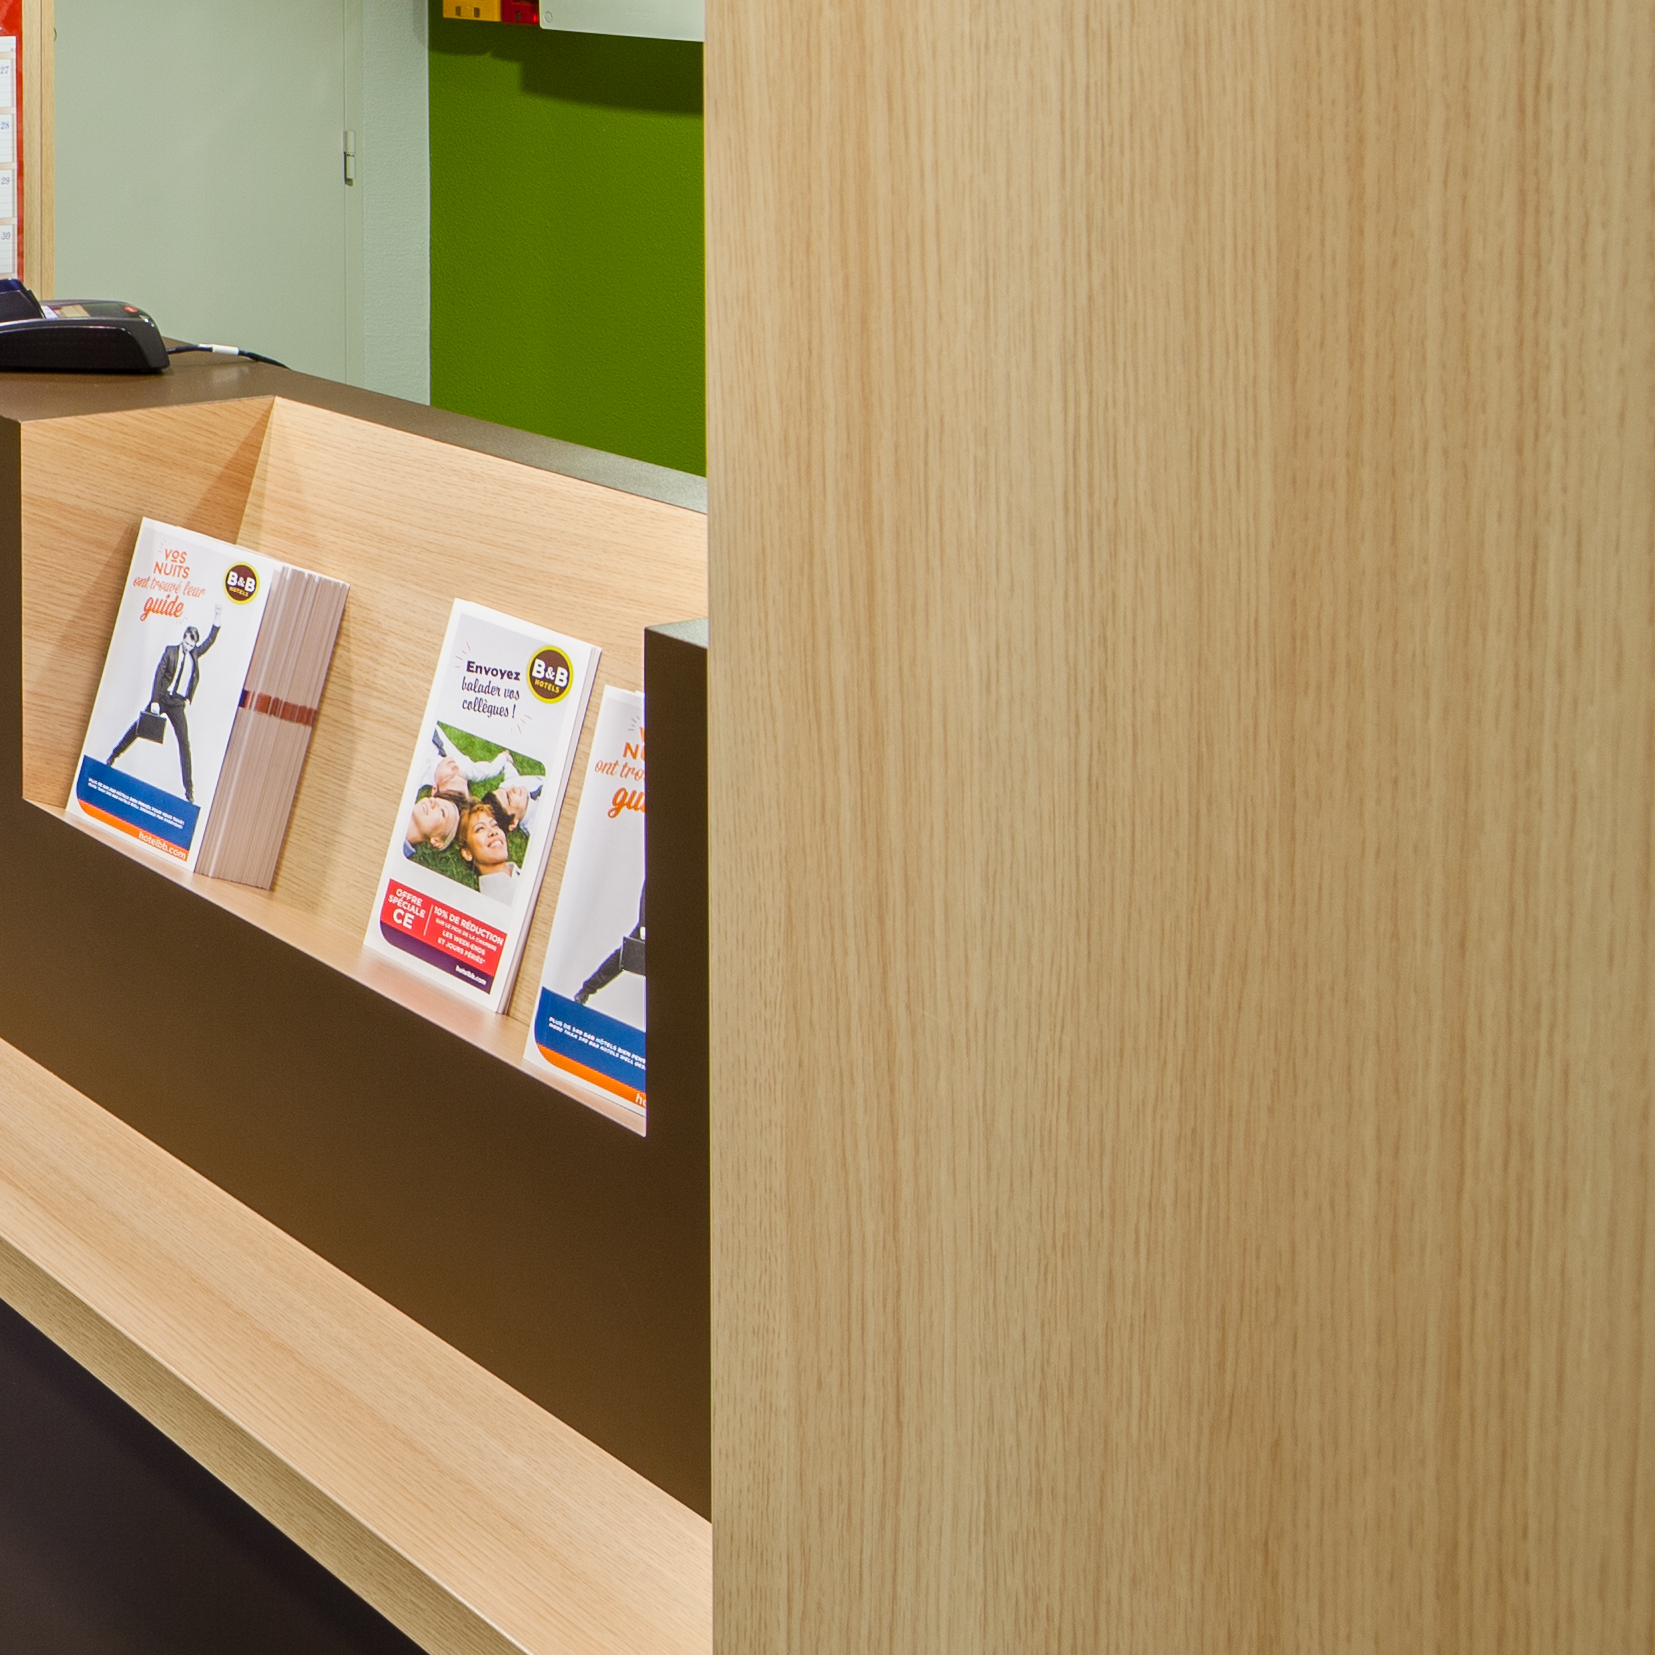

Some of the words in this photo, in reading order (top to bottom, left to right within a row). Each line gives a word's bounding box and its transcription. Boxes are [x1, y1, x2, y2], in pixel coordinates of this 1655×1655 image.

[164, 548, 188, 564] VOS
[153, 561, 190, 579] NUITS
[133, 575, 151, 588] ont
[151, 577, 183, 595] trouvé
[182, 581, 206, 597] leur
[227, 571, 256, 593] B&B
[139, 594, 184, 622] guide
[466, 660, 521, 681] Envoyez
[531, 658, 569, 688] B&B
[461, 675, 501, 697] balader
[503, 688, 520, 701] vos
[534, 679, 560, 694] HOTELS
[461, 696, 509, 718] collègues
[594, 759, 619, 776] ont
[619, 761, 645, 781] tro
[388, 894, 426, 918] SPÉCIALE
[395, 888, 423, 907] OFFRE
[392, 908, 415, 930] CE
[433, 905, 448, 920] 10%
[448, 910, 460, 925] DE
[461, 918, 504, 945] RÉDUCTION
